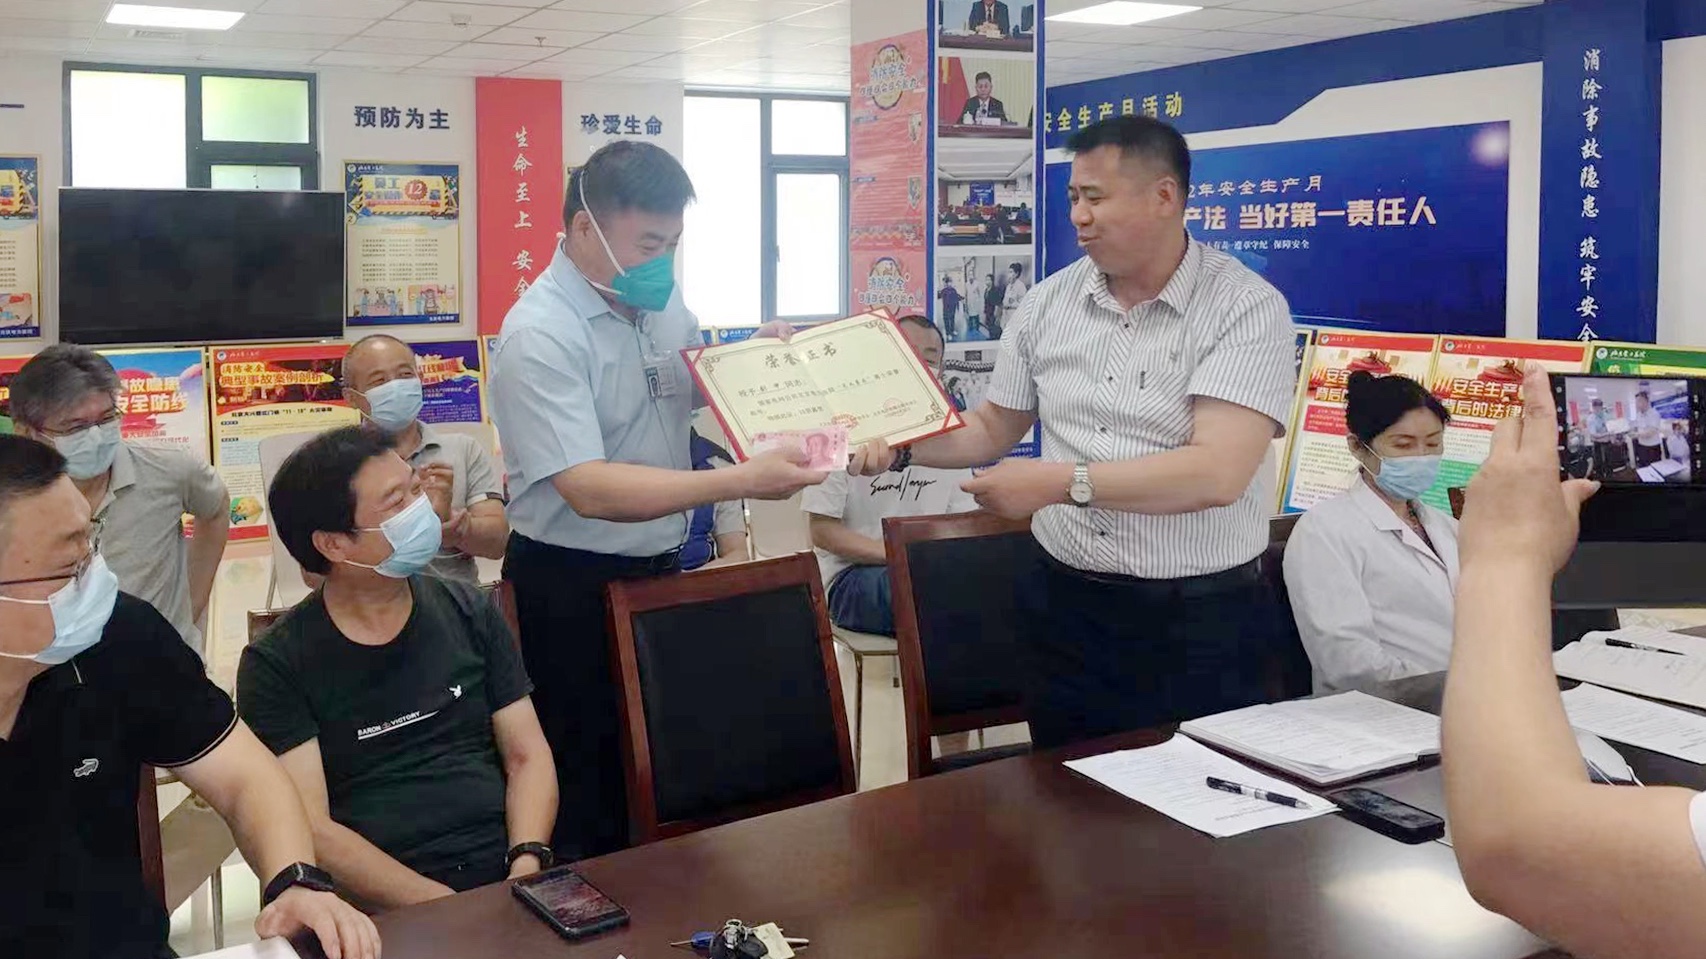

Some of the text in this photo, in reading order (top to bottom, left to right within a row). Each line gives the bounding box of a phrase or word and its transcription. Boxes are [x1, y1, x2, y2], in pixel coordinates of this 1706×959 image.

[354, 106, 450, 130] 预防为主
[580, 113, 663, 136] 珍爱生命
[1580, 48, 1602, 218] 消除事故隐患
[512, 125, 533, 231] 生命至上
[408, 183, 423, 196] 12
[1239, 196, 1437, 230] 当好第一责任人
[1234, 239, 1269, 250] 遵章守纪
[1273, 239, 1310, 249] 保障安全
[764, 341, 837, 369] 荣誉证书
[220, 371, 321, 386] 典型事故案例剖析
[222, 363, 265, 374] 消防安全
[1452, 378, 1523, 400] 安全生产
[116, 392, 188, 414] 安全防线
[1442, 398, 1525, 419] 背后的法律
[357, 711, 420, 736] BARON VICTORY
